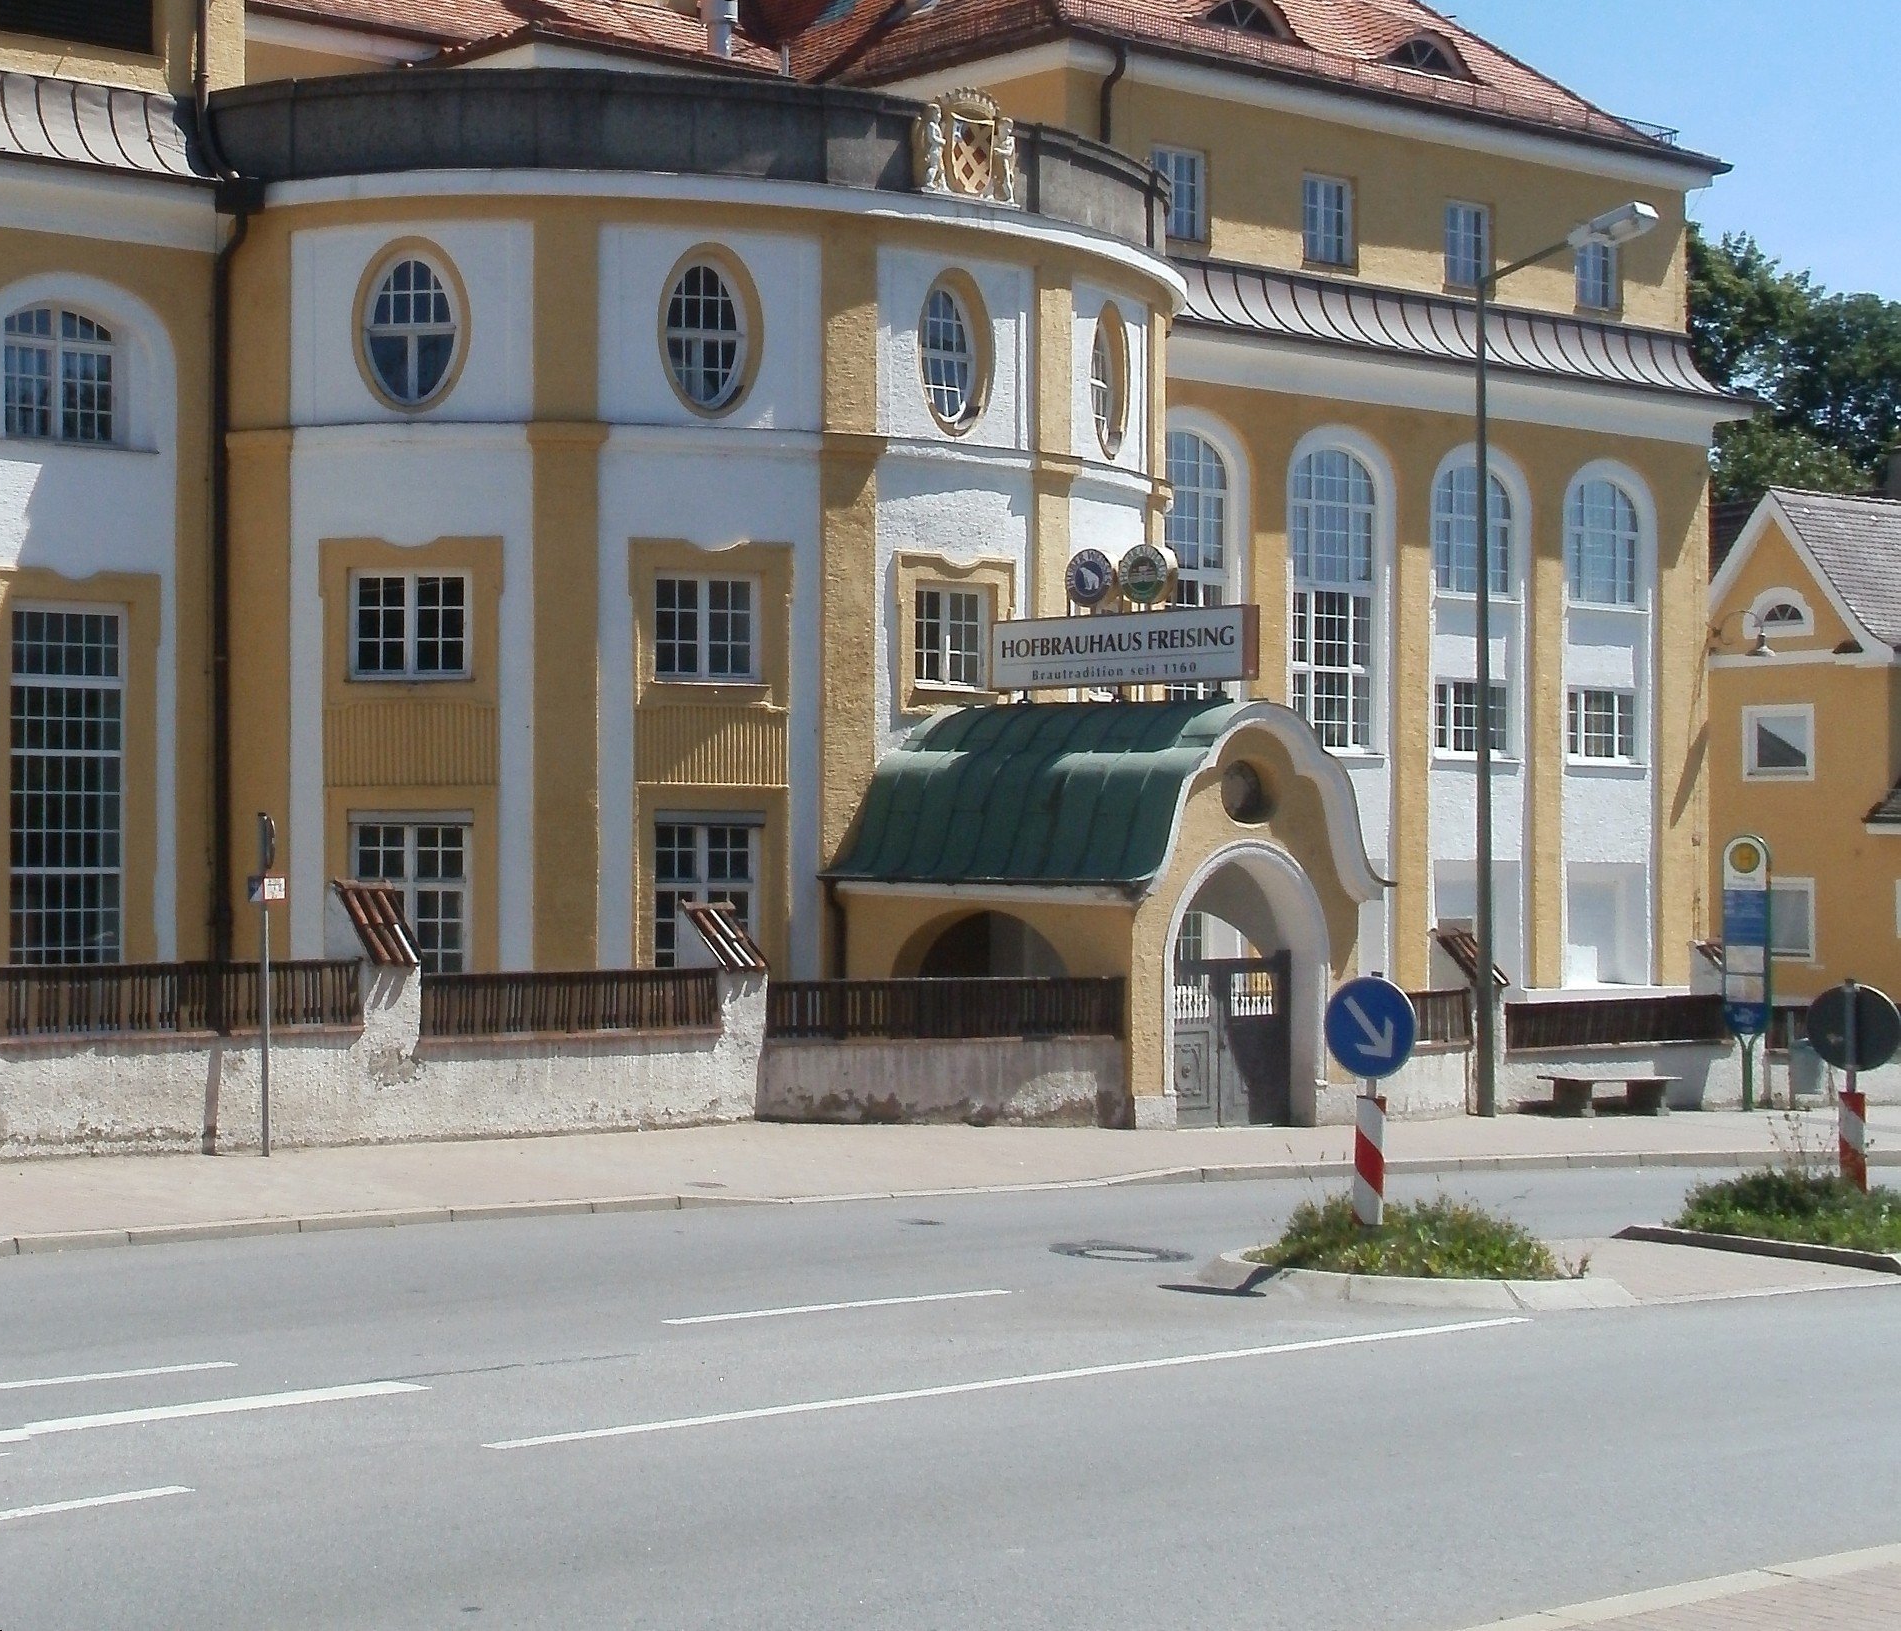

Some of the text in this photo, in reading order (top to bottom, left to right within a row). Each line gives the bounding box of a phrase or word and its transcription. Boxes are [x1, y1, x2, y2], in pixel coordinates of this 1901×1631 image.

[1001, 625, 1235, 659] HOFBRAUHAUS FREISING
[1032, 661, 1197, 681] Brautradition seit 1160
